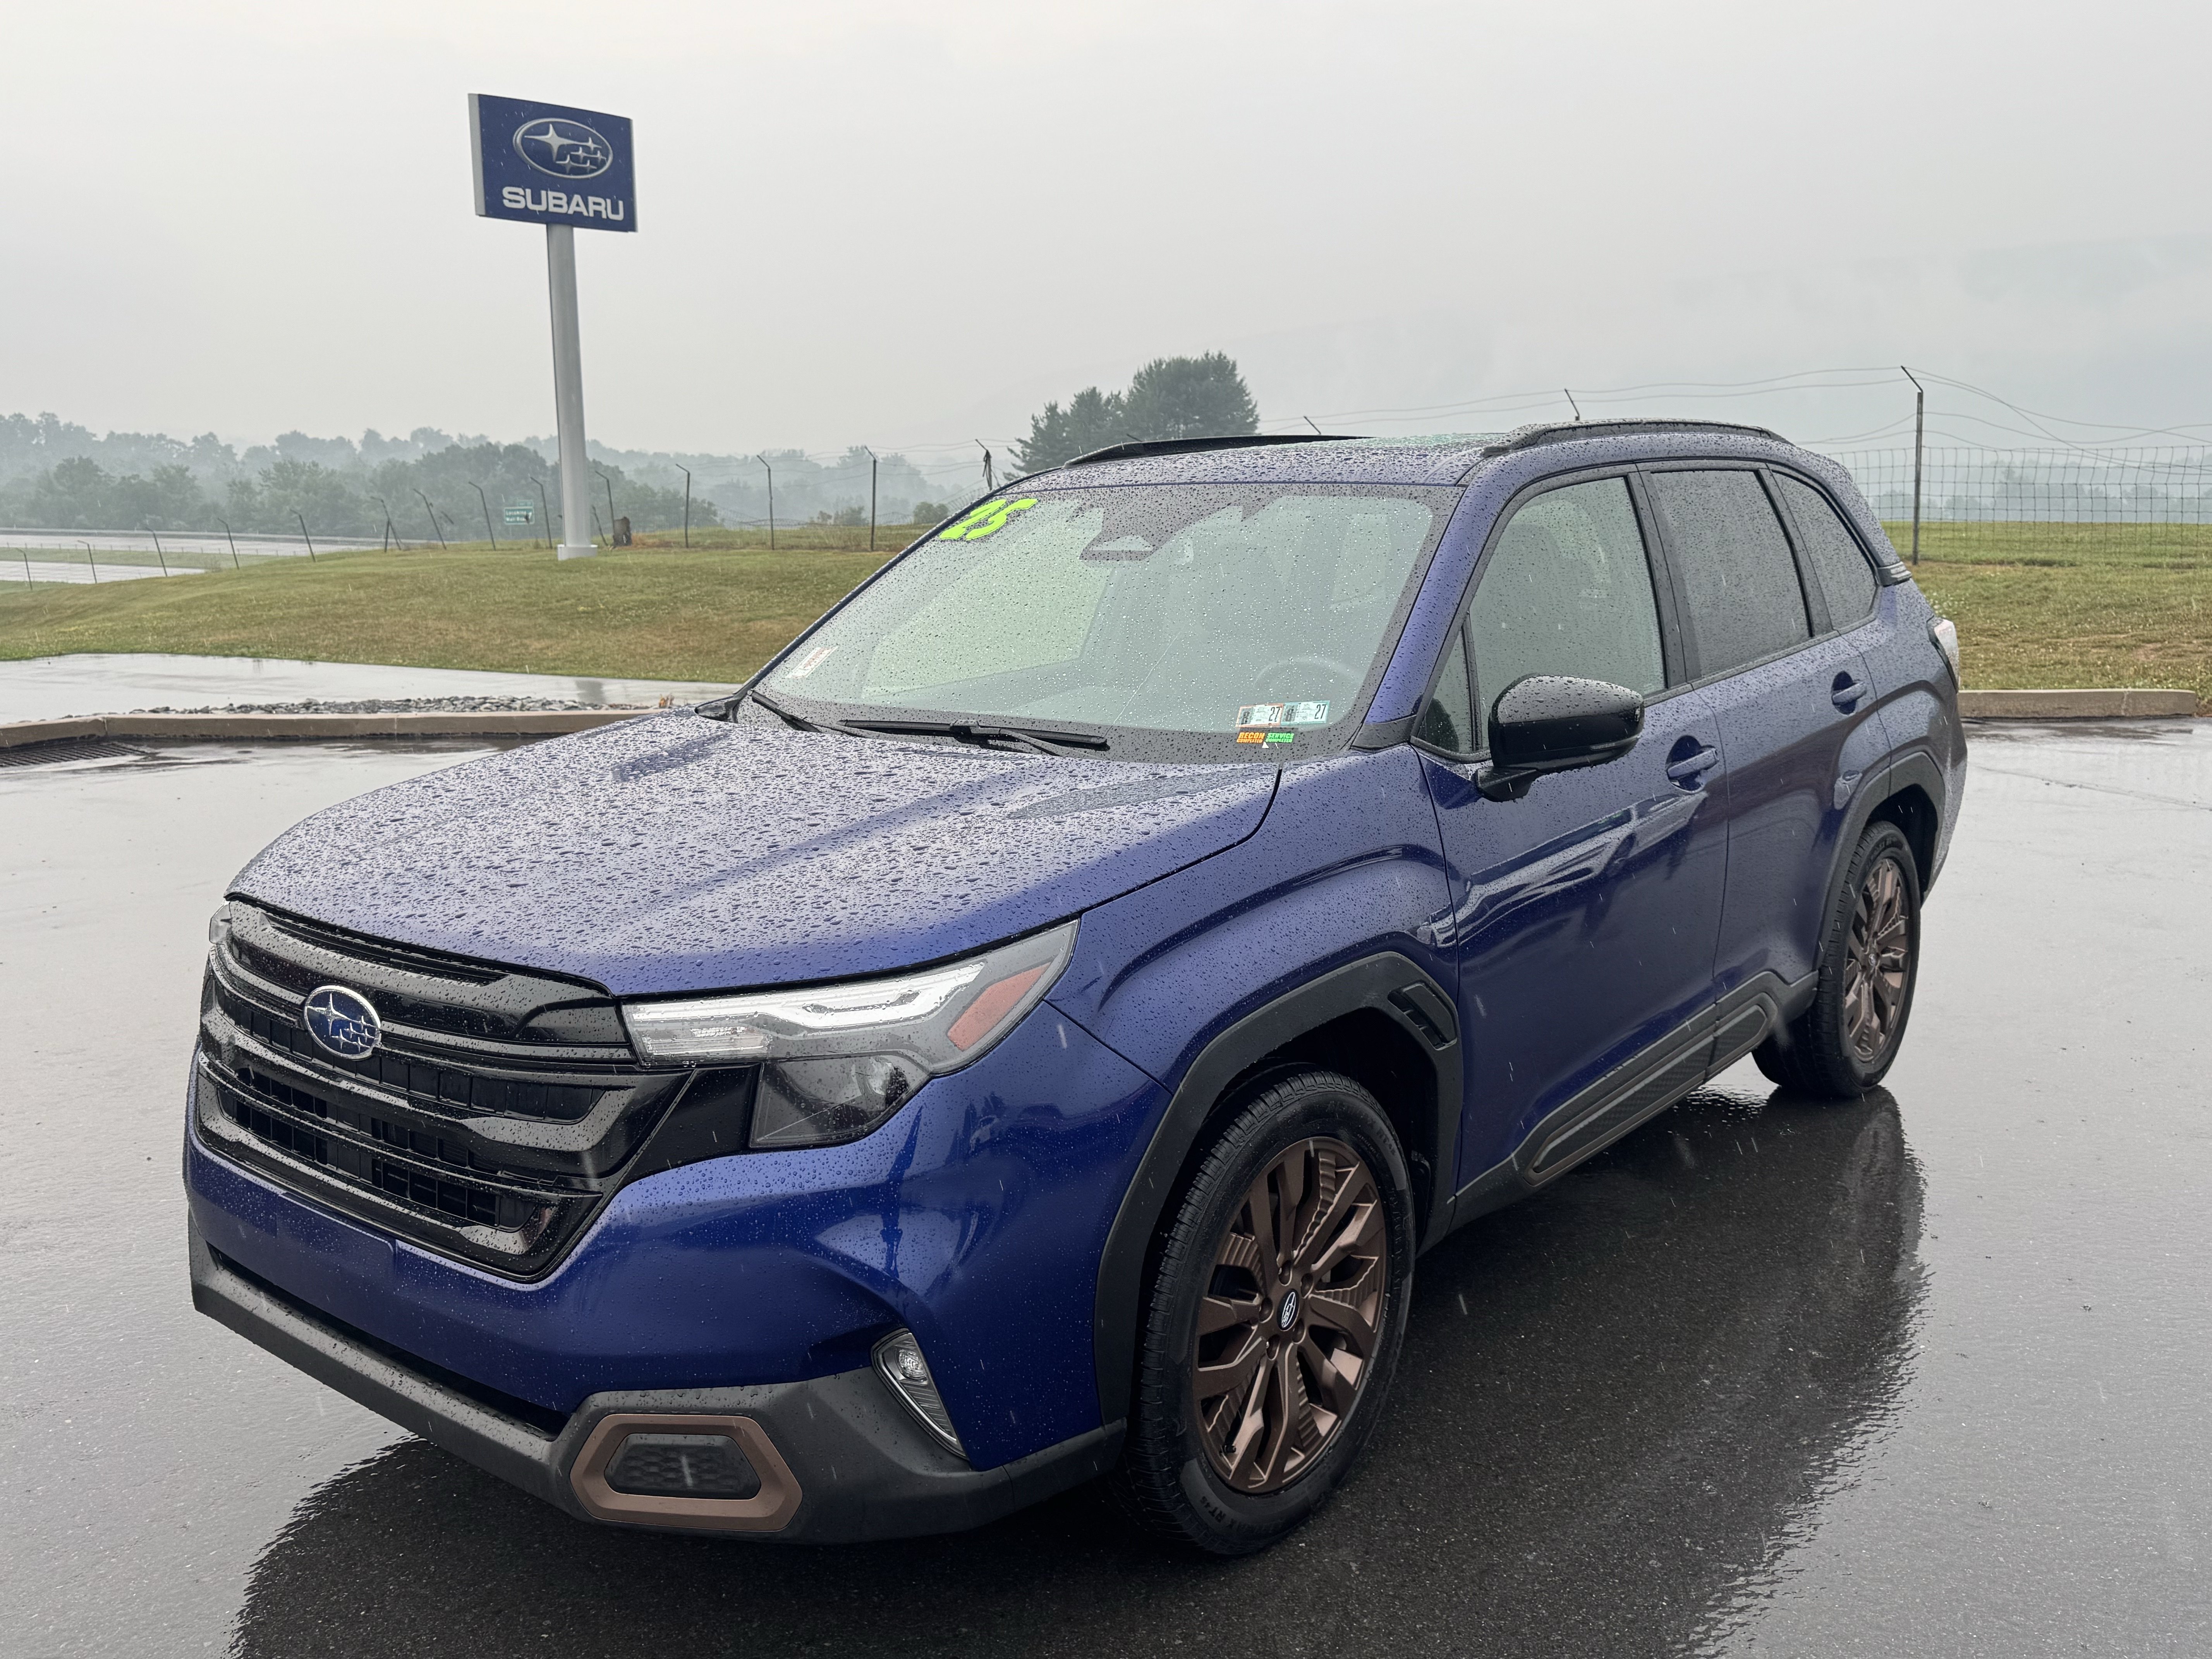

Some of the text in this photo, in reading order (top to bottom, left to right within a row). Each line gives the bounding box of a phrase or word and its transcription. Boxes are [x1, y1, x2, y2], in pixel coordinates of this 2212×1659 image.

[502, 187, 624, 221] SUBARU
[939, 499, 1038, 541] 25
[1269, 706, 1281, 722] 27
[1285, 708, 1294, 722] 8
[1314, 704, 1327, 719] 27
